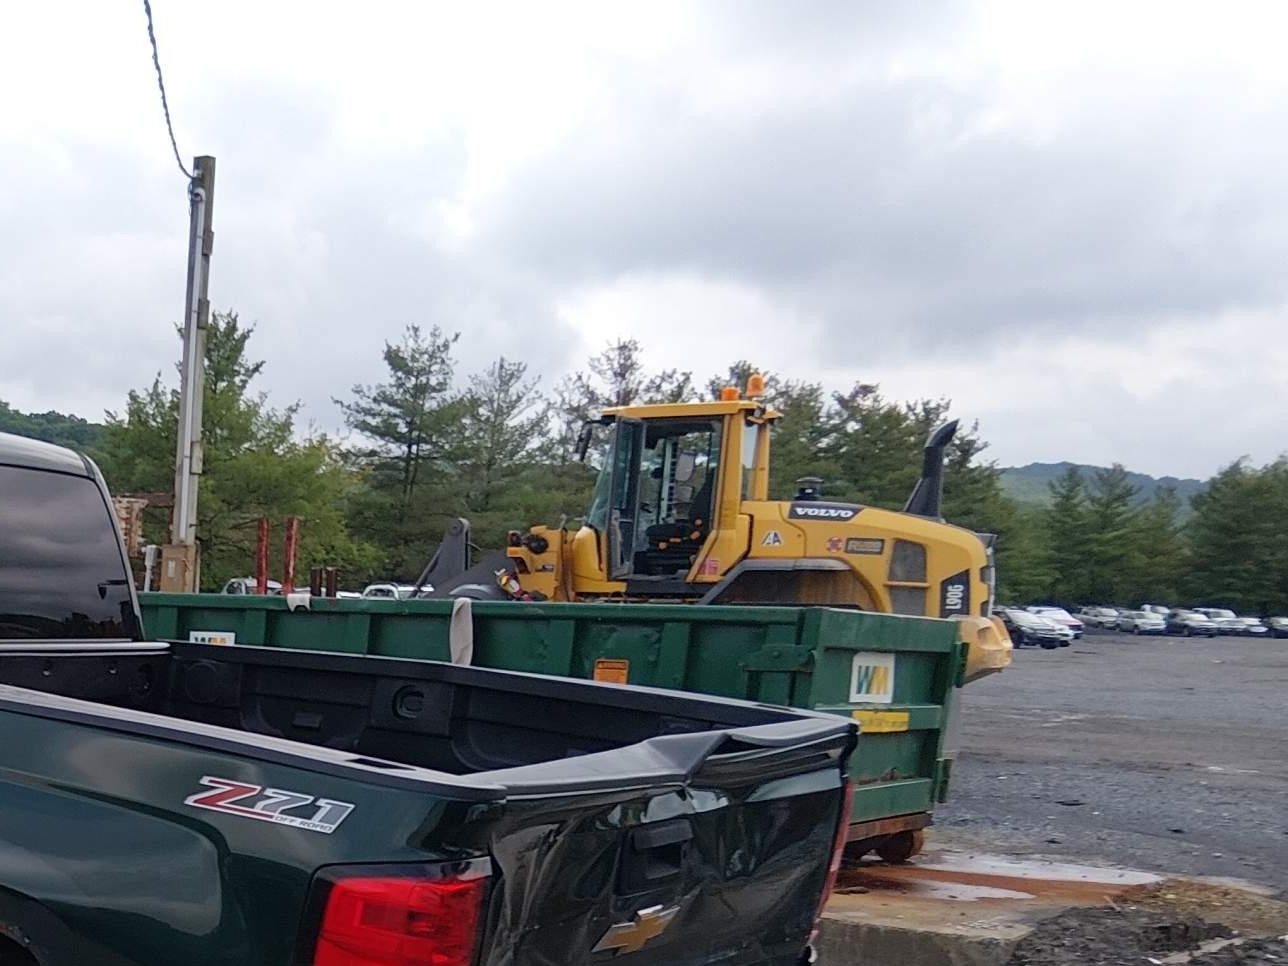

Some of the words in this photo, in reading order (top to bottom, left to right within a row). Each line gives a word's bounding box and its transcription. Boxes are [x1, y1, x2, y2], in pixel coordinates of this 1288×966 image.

[794, 507, 855, 518] VOLVO
[945, 584, 965, 610] L90G
[854, 665, 890, 695] WM
[183, 775, 356, 824] Z71
[274, 815, 295, 825] OFF
[298, 819, 334, 832] ROAD
